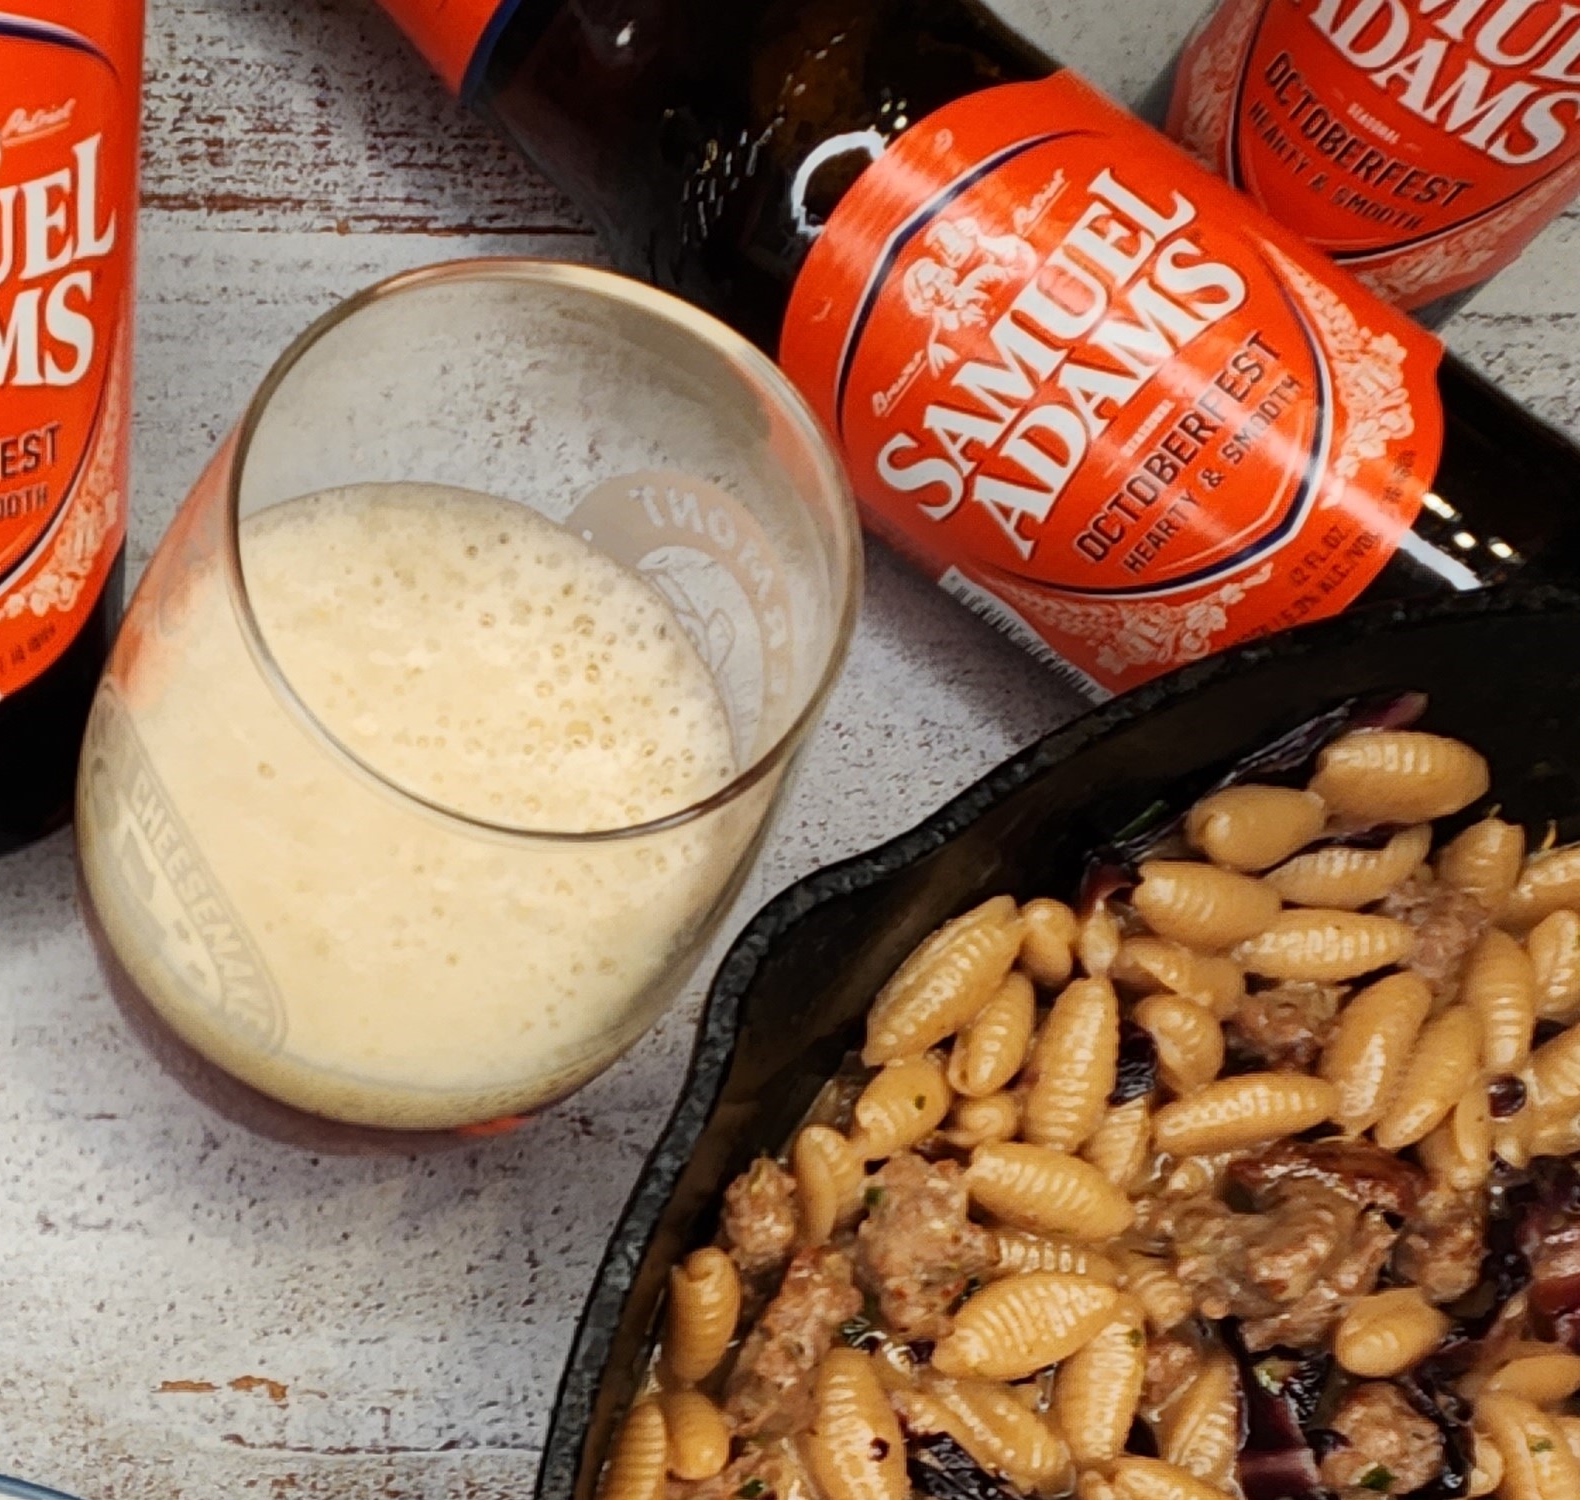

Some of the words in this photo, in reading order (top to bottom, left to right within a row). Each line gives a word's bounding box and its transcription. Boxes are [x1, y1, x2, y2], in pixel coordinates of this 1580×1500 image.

[1248, 102, 1312, 176] HEARTY
[1308, 172, 1328, 194] &
[1332, 186, 1424, 231] SMOOTH
[1264, 51, 1474, 208] OCTOBERFEST
[1309, 0, 1580, 165] DAMS
[876, 167, 1197, 521] SAMUEL
[972, 237, 1249, 560] ADAMS
[1074, 330, 1281, 565] OCTOBERFEST
[1123, 489, 1201, 575] HEARTY
[1197, 467, 1226, 490] &
[1221, 369, 1302, 466] SMOOTH
